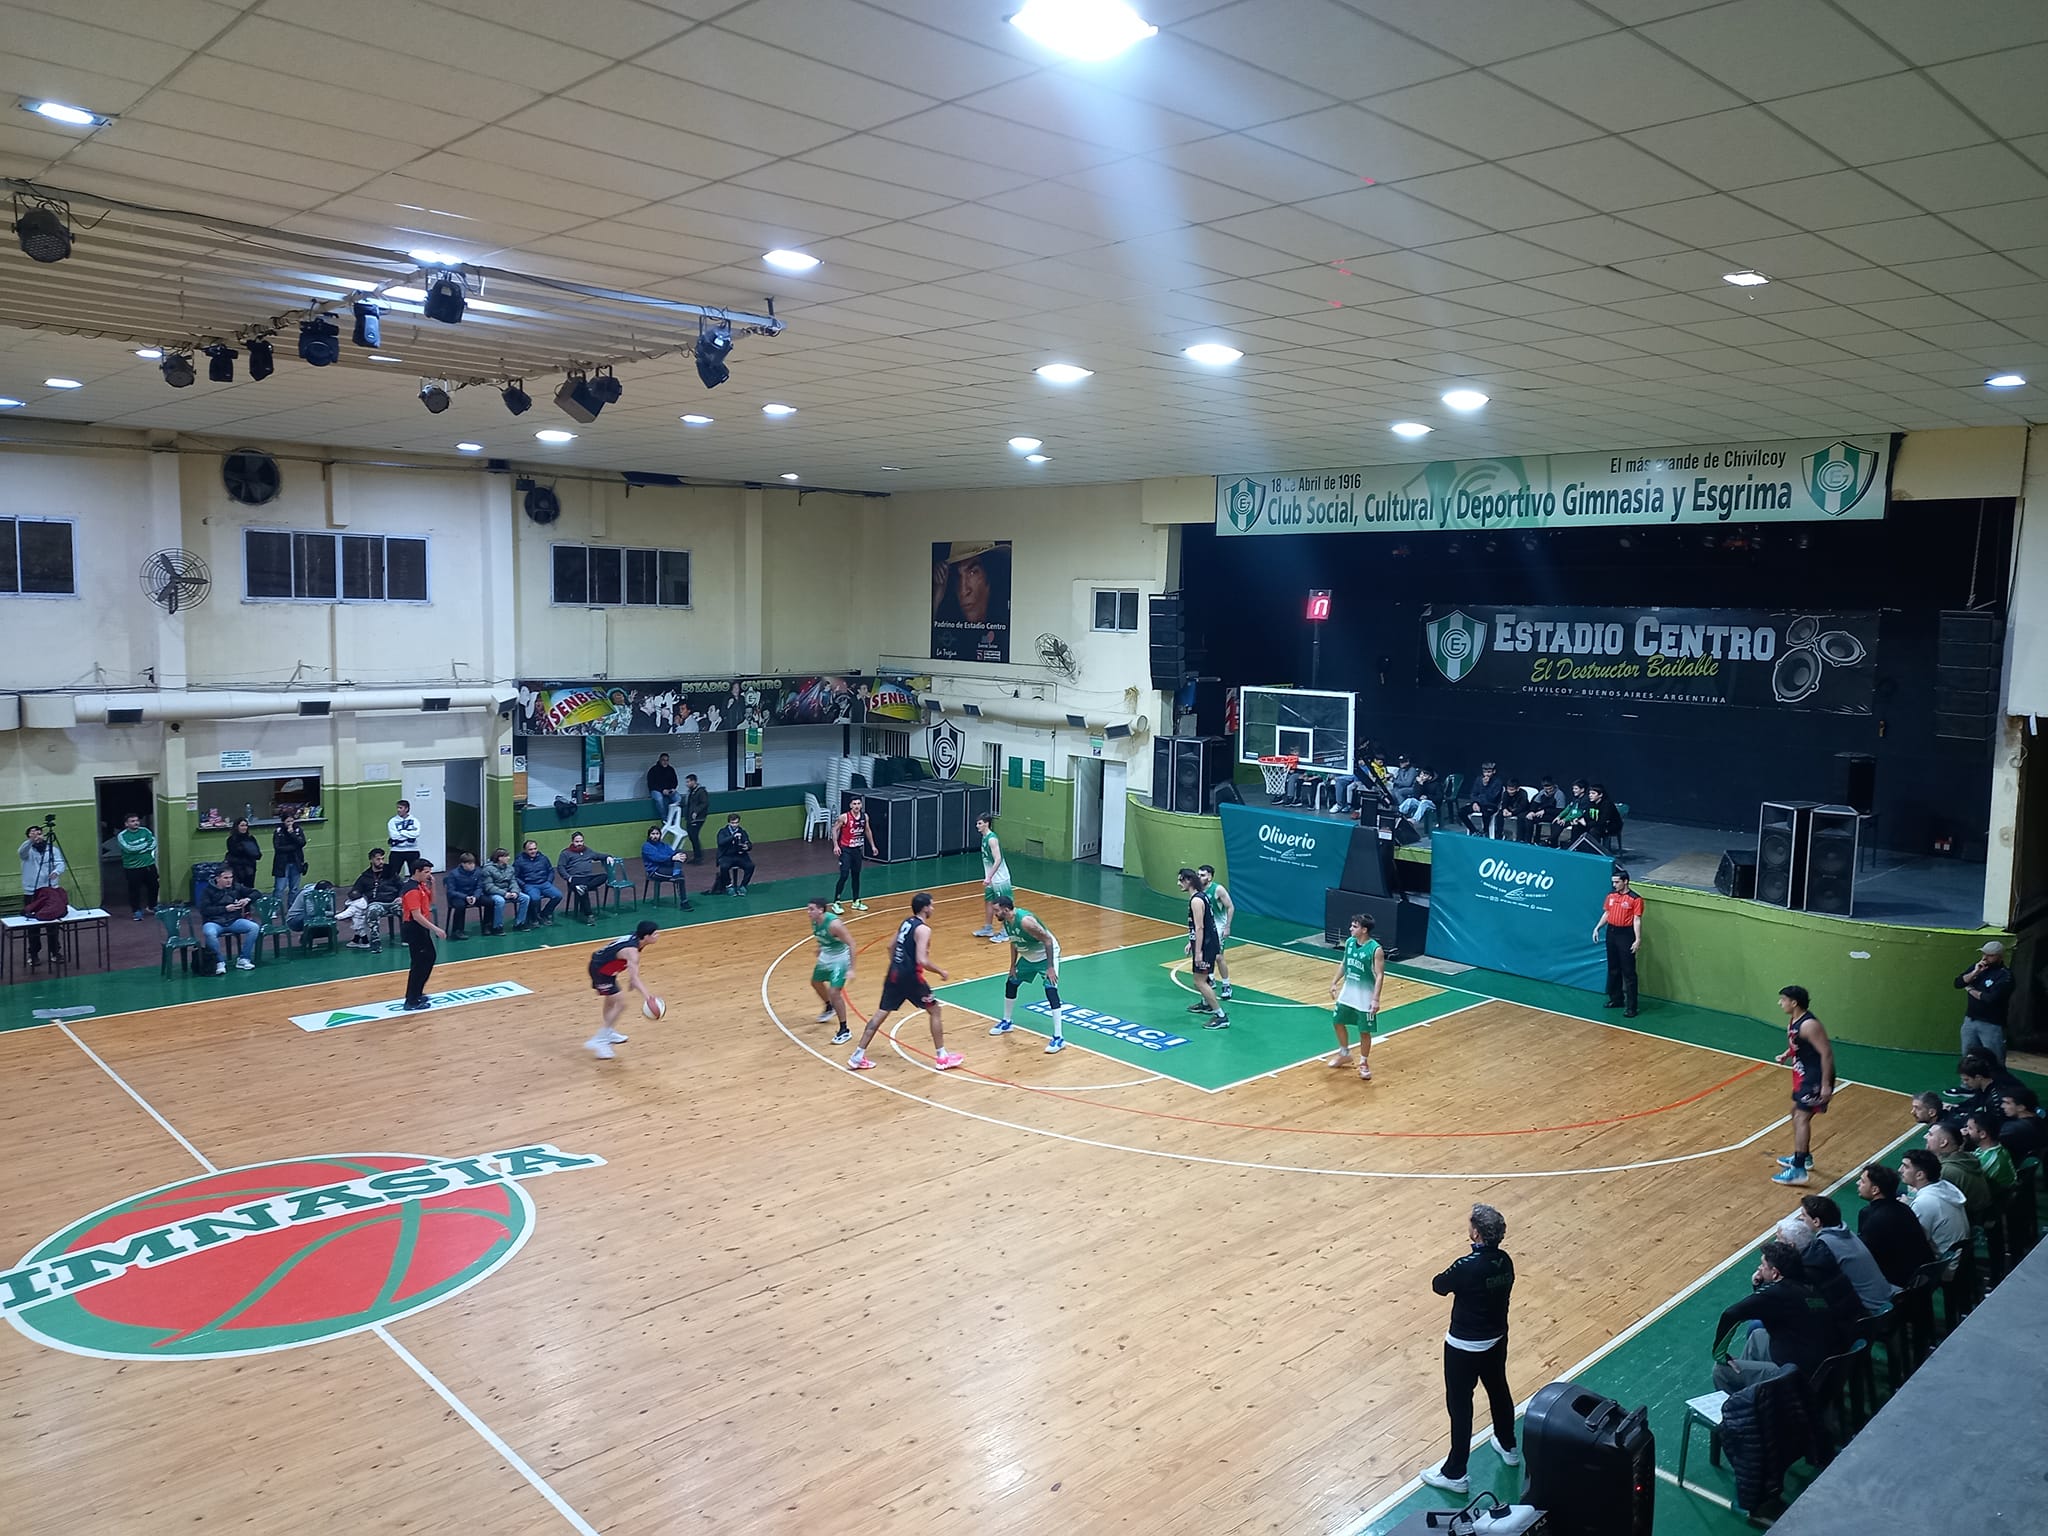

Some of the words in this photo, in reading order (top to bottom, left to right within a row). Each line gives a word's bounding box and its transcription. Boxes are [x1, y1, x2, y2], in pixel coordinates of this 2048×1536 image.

[1610, 457, 1622, 473] El
[1625, 456, 1651, 473] más
[1703, 451, 1720, 469] de
[1724, 450, 1786, 469] Chivilcoy
[1271, 477, 1282, 493] 18
[1298, 475, 1322, 491] Abril
[1323, 475, 1336, 490] de
[1338, 473, 1361, 489] 1916
[1267, 494, 1301, 526] Club
[1306, 490, 1359, 527] Social,
[1364, 489, 1434, 523] Cultural
[1439, 498, 1452, 528] y
[1456, 485, 1556, 527] Deportivo
[1562, 478, 1664, 516] Gimnasia
[1670, 485, 1687, 522] y
[1692, 473, 1792, 520] Esgrima
[934, 621, 955, 629] Padrino
[964, 622, 986, 630] Estadio
[986, 622, 1007, 631] Centro
[1530, 658, 1551, 683] El
[1555, 656, 1641, 681] Destructor
[1646, 652, 1719, 679] Bailable
[681, 681, 730, 694] ESTADIO
[1522, 685, 1573, 695] CHIVILCOY
[1581, 688, 1621, 698] BUENOS
[1623, 690, 1654, 700] AIRES
[1663, 693, 1727, 704] ARGENTINA
[1258, 824, 1316, 850] Oliverio
[1478, 858, 1554, 890] Oliverio
